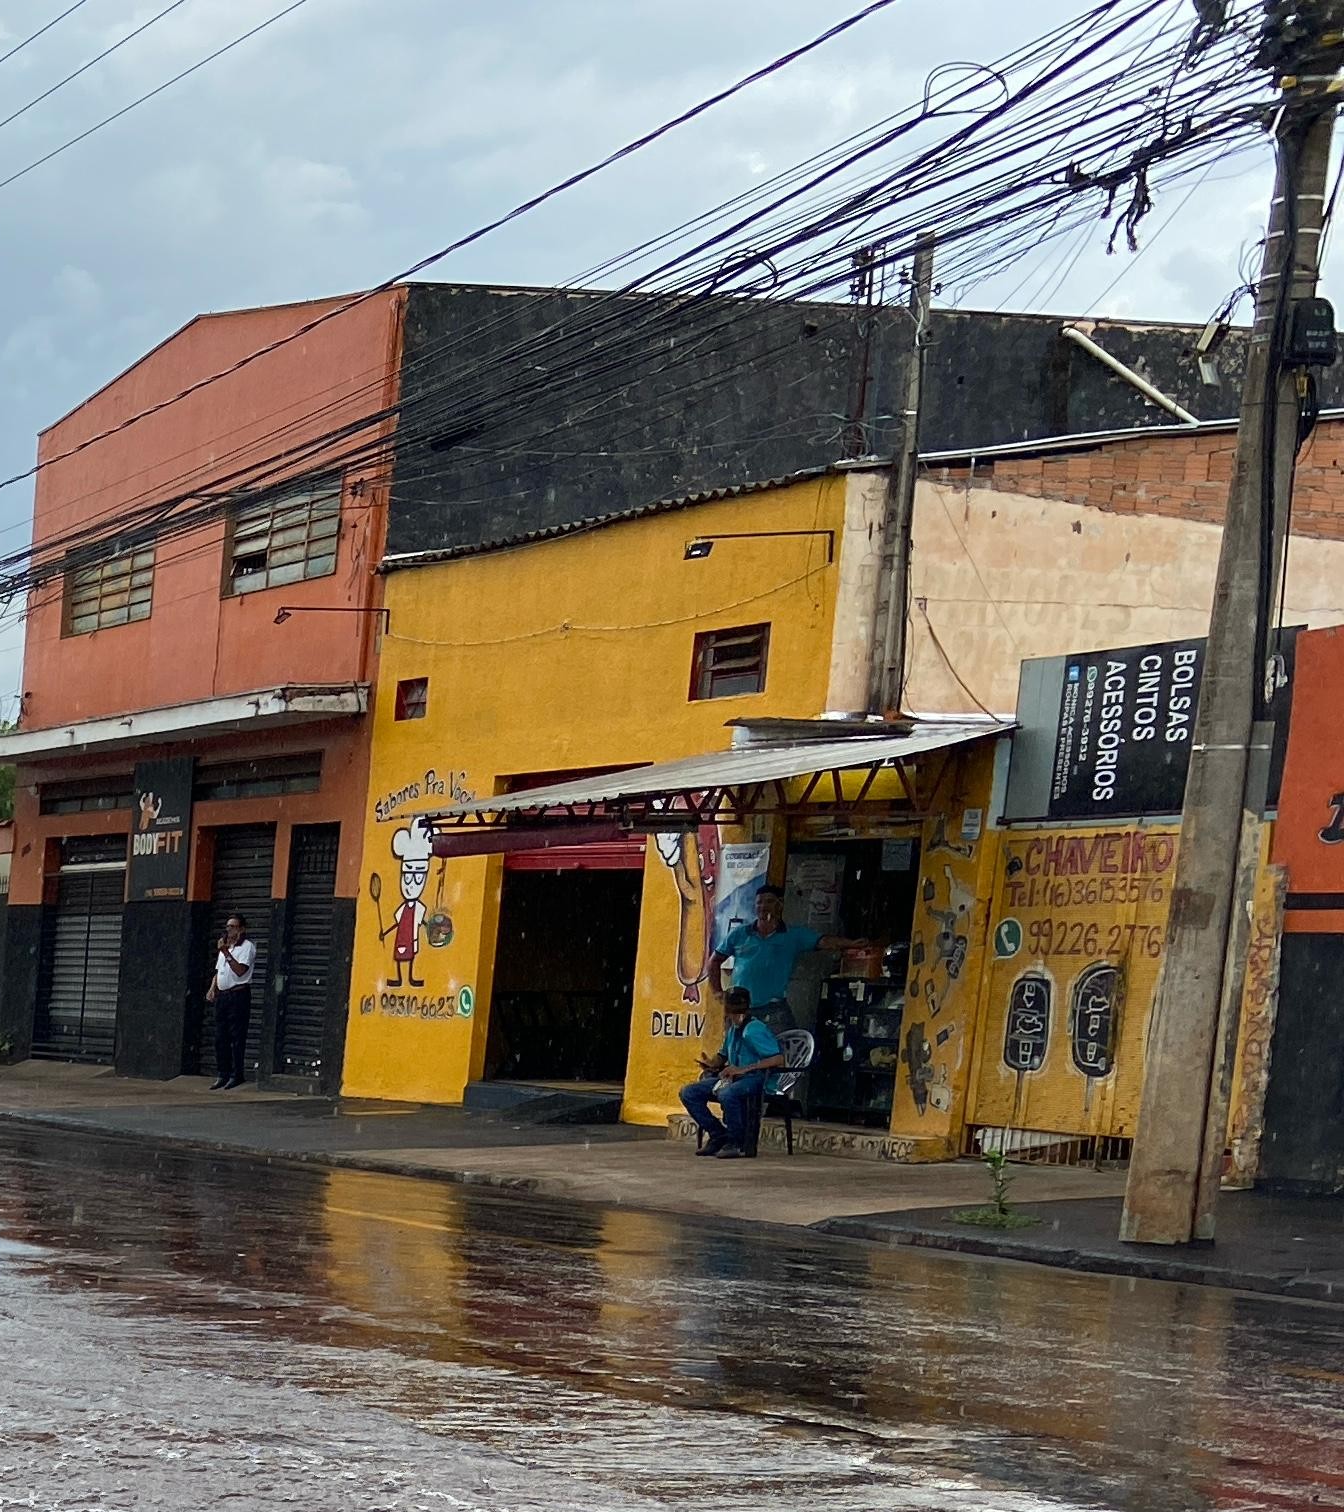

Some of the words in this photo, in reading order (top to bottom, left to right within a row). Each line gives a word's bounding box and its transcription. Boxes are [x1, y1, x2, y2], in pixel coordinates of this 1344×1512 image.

[1132, 655, 1162, 741] CINTOS
[1165, 649, 1198, 742] BOLSAS
[1092, 661, 1127, 801] ACESSÓRIOS
[375, 783, 420, 818] Sabores
[425, 769, 444, 795] Pra
[1025, 831, 1174, 876] CHAVEIRO
[672, 1119, 697, 1137] TUD
